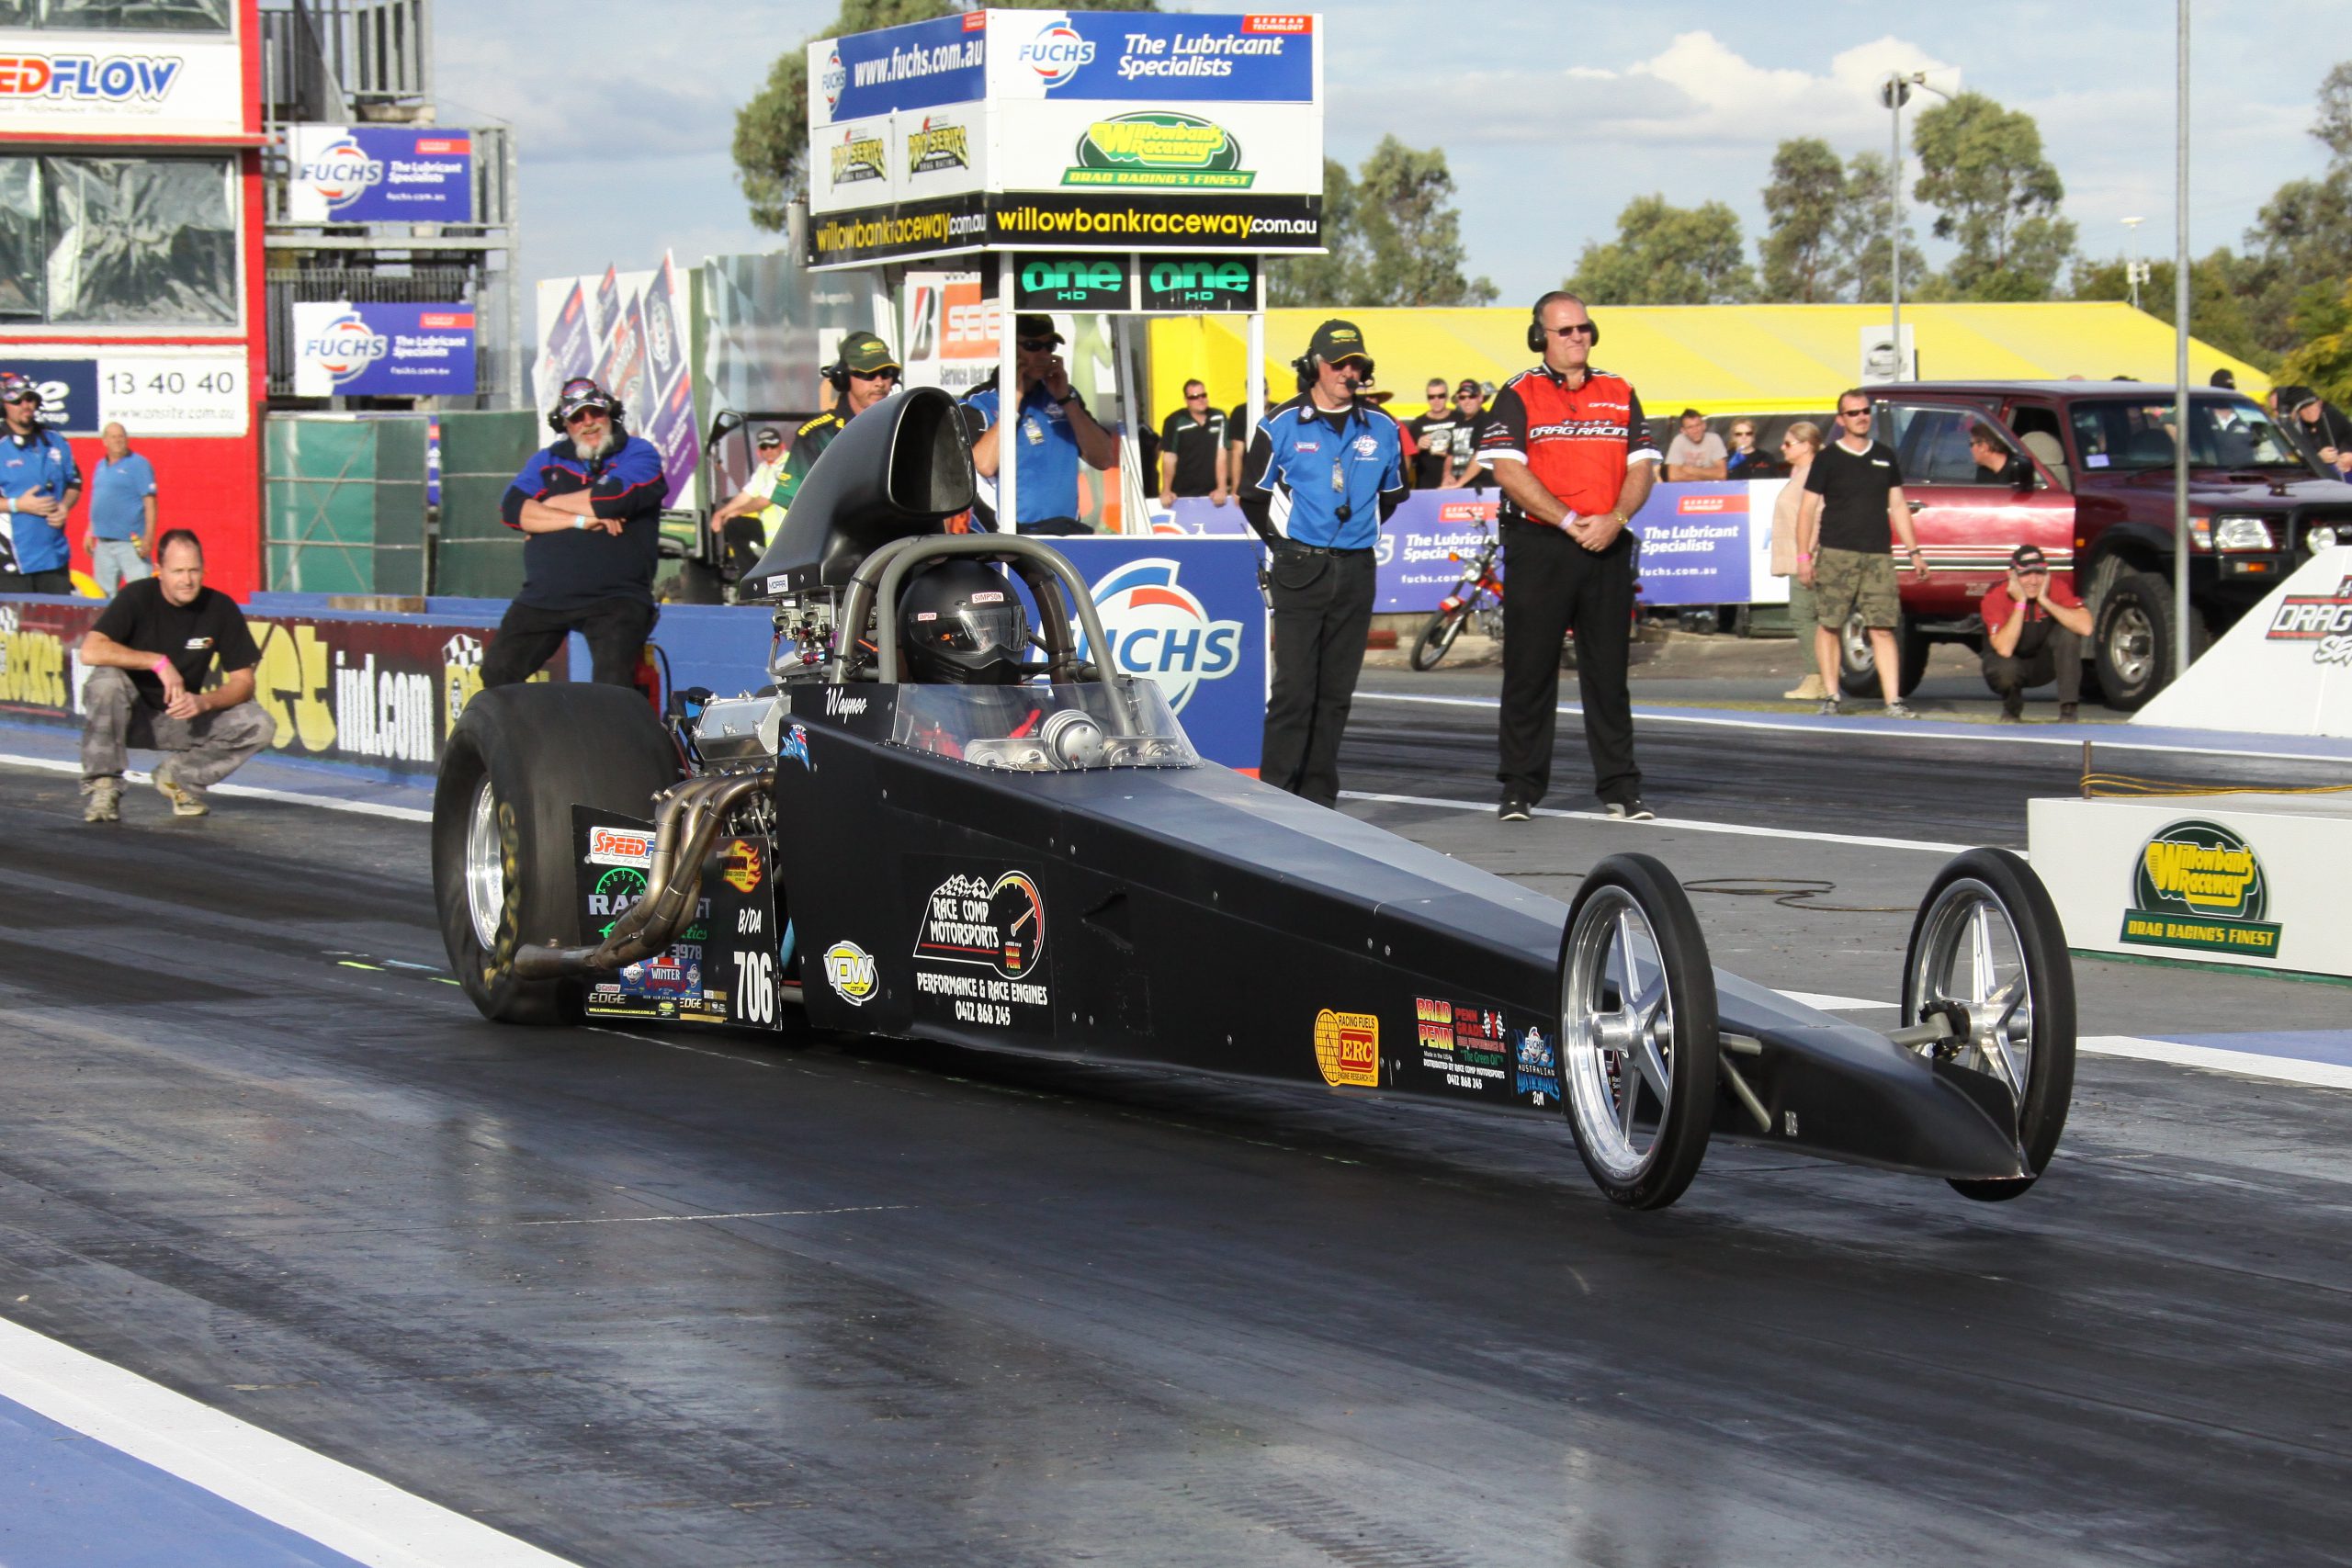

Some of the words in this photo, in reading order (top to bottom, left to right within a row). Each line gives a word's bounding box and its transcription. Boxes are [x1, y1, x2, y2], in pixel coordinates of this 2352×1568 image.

[1020, 45, 1094, 62] FUCHS
[1125, 34, 1163, 54] The
[1172, 34, 1283, 55] Lubricant
[854, 39, 984, 87] www.fuchs.com.au
[1118, 56, 1232, 80] Specialists
[822, 71, 845, 90] FUCHS
[1090, 122, 1224, 152] Willowbank
[929, 126, 970, 169] SERIES
[1130, 140, 1209, 162] Raceway
[390, 161, 412, 173] The
[413, 162, 462, 173] Lubricant
[851, 139, 886, 181] SERIES
[300, 164, 380, 181] FUCHS
[388, 173, 444, 184] Specialists
[1069, 173, 1113, 183] DRAG
[1117, 174, 1188, 184] RACING'S
[1193, 175, 1248, 185] FINEST
[817, 213, 986, 252] willowbankraceway.com.au
[996, 208, 1317, 239] willowbankraceway.com.au
[1022, 261, 1122, 293] one
[1150, 261, 1250, 293] one
[1057, 291, 1087, 300] HD
[1185, 291, 1214, 300] HD
[305, 338, 384, 356] FUCHS
[394, 335, 416, 347] The
[417, 336, 467, 347] Lubricant
[392, 346, 449, 359] Specialists
[107, 372, 135, 394] 13
[148, 372, 185, 394] 40
[198, 372, 233, 394] 40
[797, 413, 835, 435] OFFICIAL
[1530, 426, 1575, 438] DRAG
[1577, 427, 1629, 436] RACIN
[1406, 535, 1430, 547] The
[1644, 526, 1669, 539] The
[1672, 525, 1738, 538] Lubricant
[1641, 540, 1714, 556] Specialists
[1640, 567, 1717, 577] fuchs.com.au
[769, 581, 786, 590] MOPAR
[974, 592, 1002, 603] SIMPSON
[2270, 604, 2352, 632] DRAG
[2146, 840, 2254, 890] Willowbank
[2178, 869, 2242, 907] Raceway
[933, 897, 957, 920] RACE
[963, 900, 989, 922] COMP
[738, 908, 762, 935] B/DA
[930, 920, 999, 949] MOTORSPORTS
[2128, 920, 2162, 938] DRAG
[2166, 923, 2225, 942] RACING'S
[2229, 928, 2274, 948] FINEST
[651, 968, 680, 980] WINTER
[734, 952, 773, 1023] 706
[917, 973, 977, 997] PERFORMANCE
[979, 979, 986, 998] &
[988, 980, 1009, 1001] RACE
[1012, 983, 1048, 1005] ENGINES
[588, 993, 627, 1004] EDGE
[680, 998, 702, 1009] EDGE
[956, 1001, 975, 1021] 0412
[978, 1003, 993, 1024] 868
[995, 1005, 1010, 1026] 245
[1416, 998, 1452, 1023] BRAD
[1455, 1008, 1478, 1022] PENN
[1339, 1016, 1357, 1027] RACING
[1359, 1016, 1374, 1029] FUELS
[1456, 1021, 1485, 1037] GRADE
[1419, 1024, 1453, 1051] PENN
[1526, 1039, 1544, 1050] FUCHS
[1341, 1039, 1373, 1063] ERC
[1475, 1052, 1489, 1064] Green
[1454, 1064, 1464, 1073] RACE
[1465, 1065, 1476, 1074] COMP
[1476, 1067, 1505, 1079] MOTORSPORTS
[1518, 1065, 1555, 1077] AUSTRALIAN
[1447, 1074, 1460, 1086] 0412
[1461, 1076, 1471, 1088] 868
[1473, 1077, 1482, 1089] 245
[1517, 1071, 1560, 1102] NATIONALS
